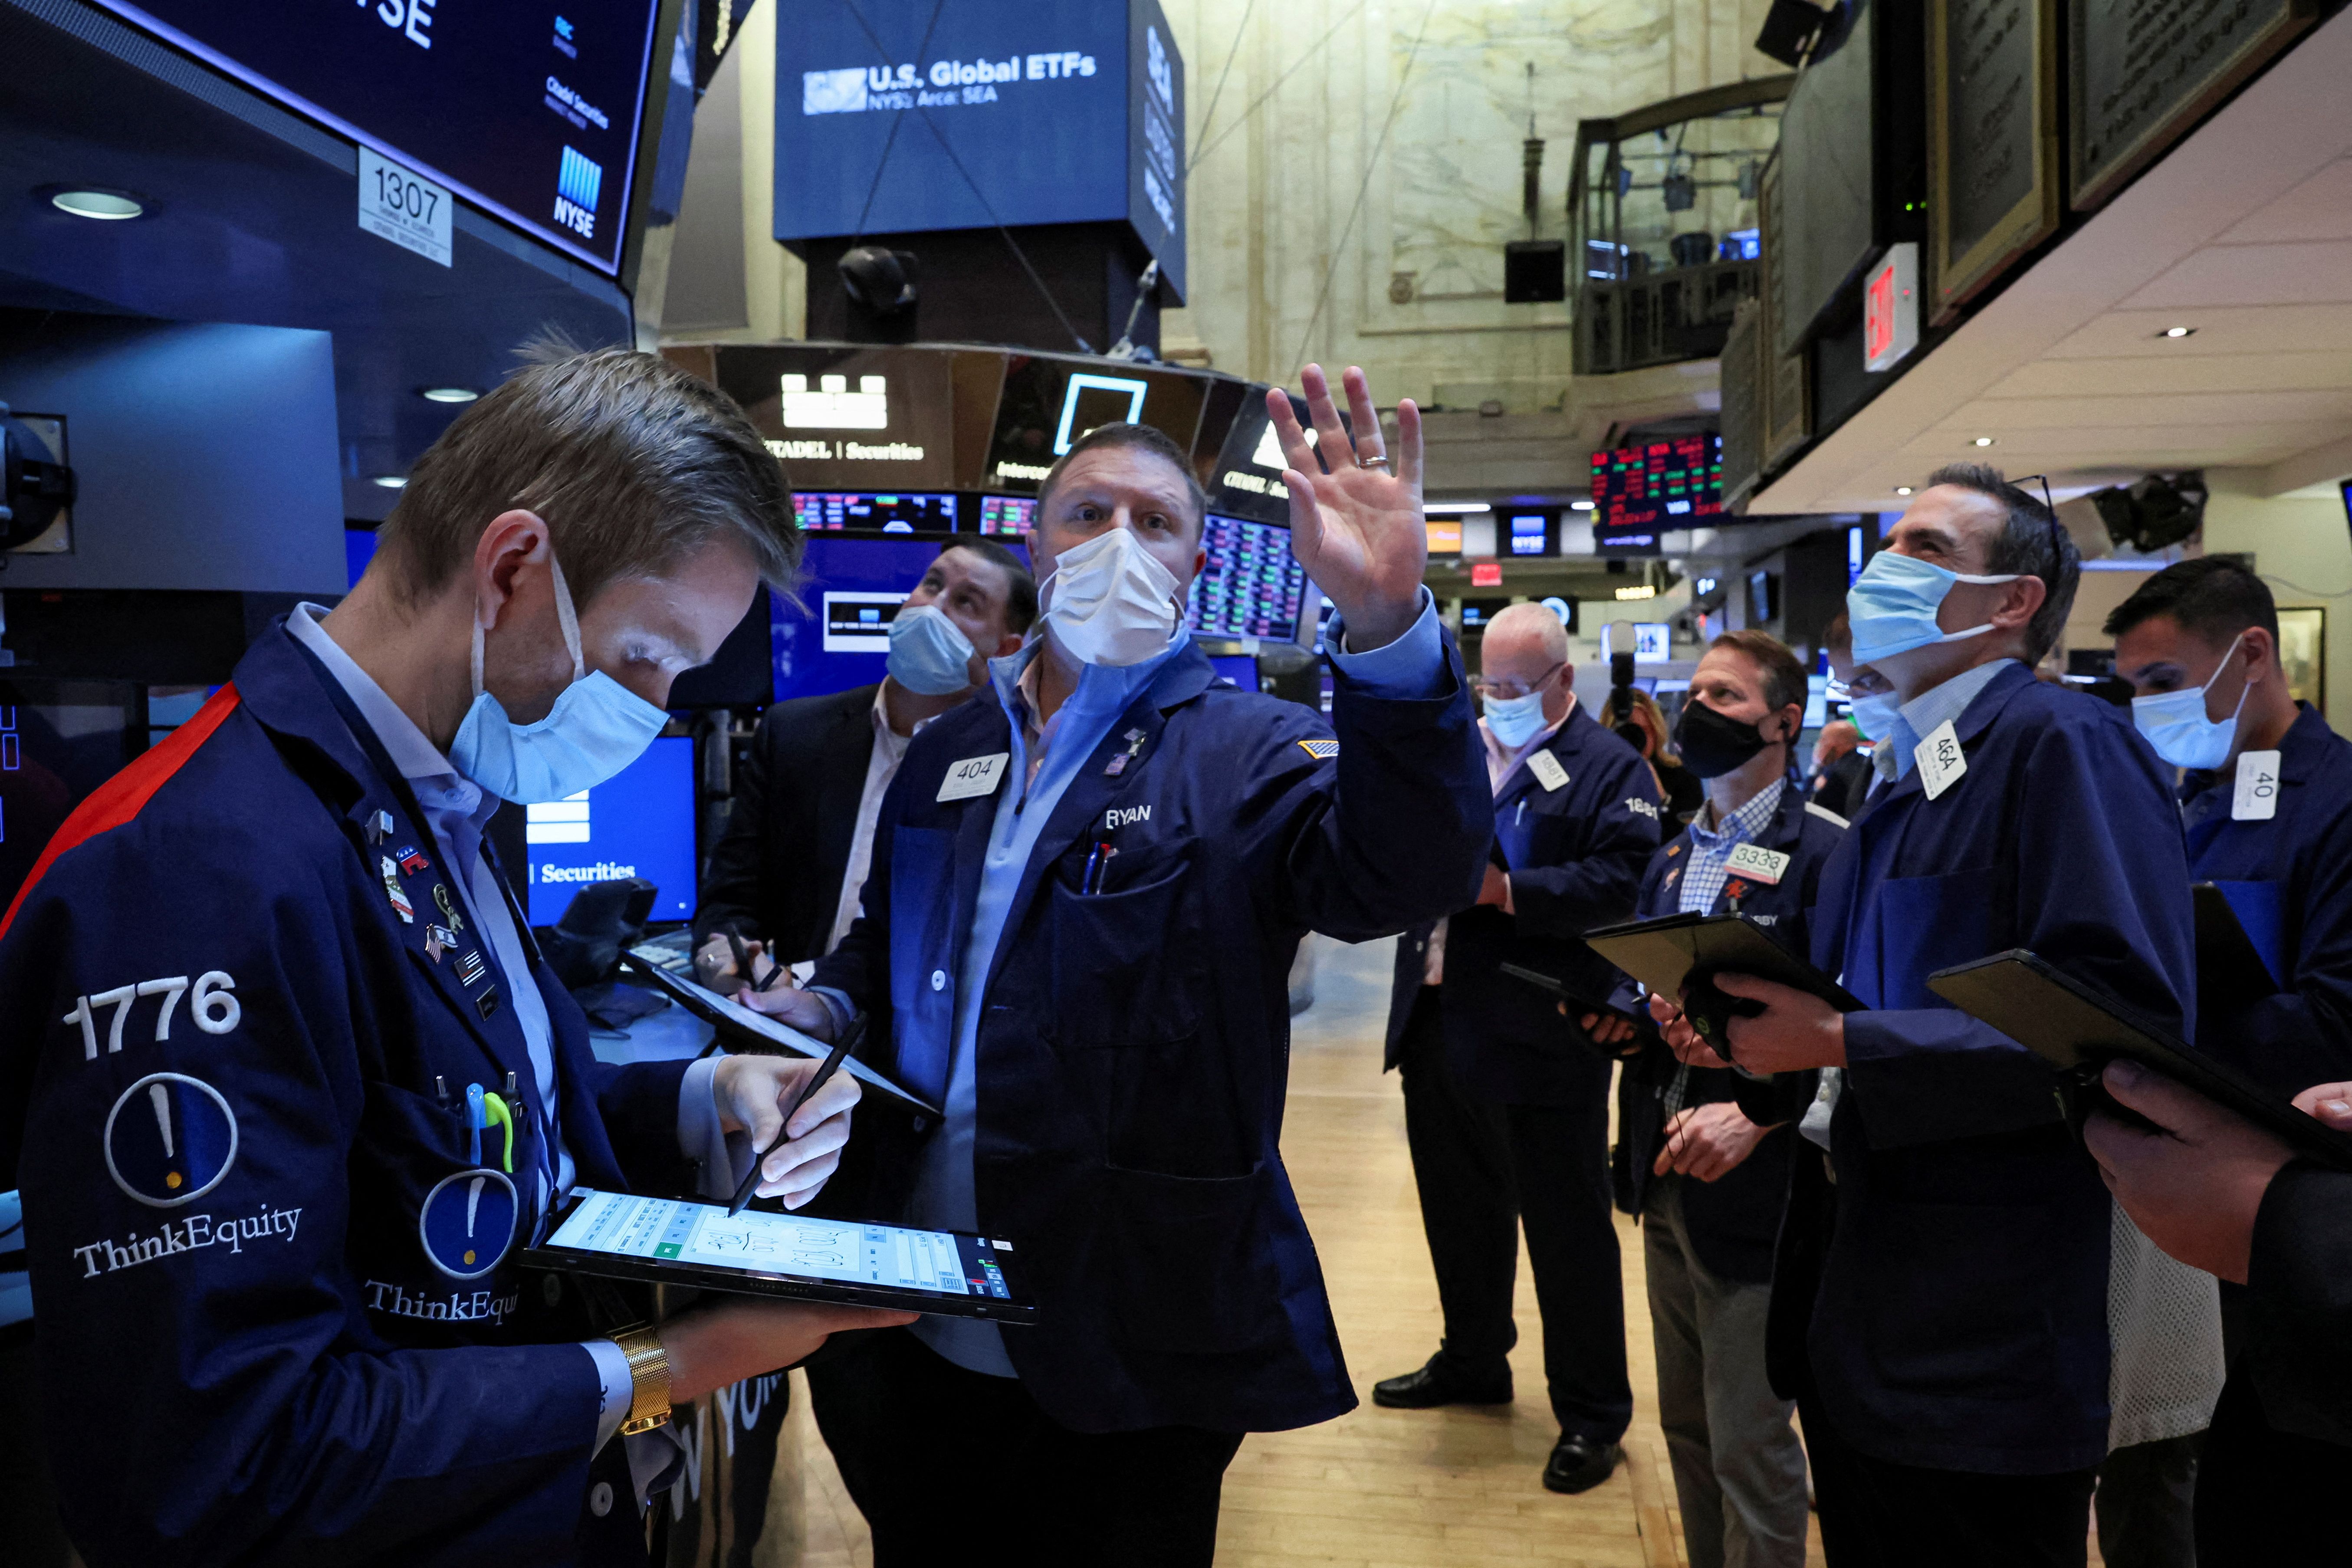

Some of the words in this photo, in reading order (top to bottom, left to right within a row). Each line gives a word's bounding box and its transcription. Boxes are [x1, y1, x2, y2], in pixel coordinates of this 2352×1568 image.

[357, 0, 436, 49] SE
[869, 63, 924, 92] U.S.
[930, 56, 1020, 87] Global
[1026, 52, 1097, 80] ETFs
[375, 166, 438, 225] 1307
[554, 196, 596, 239] NYSE
[764, 440, 833, 459] TADEL
[845, 441, 924, 460] Securities
[957, 759, 993, 780] 404
[1936, 738, 1957, 771] 464
[2254, 771, 2274, 798] 40
[1106, 805, 1152, 826] RYAN
[542, 861, 636, 884] Securities
[62, 970, 241, 1061] 1776
[73, 1204, 302, 1279] ThinkEquity
